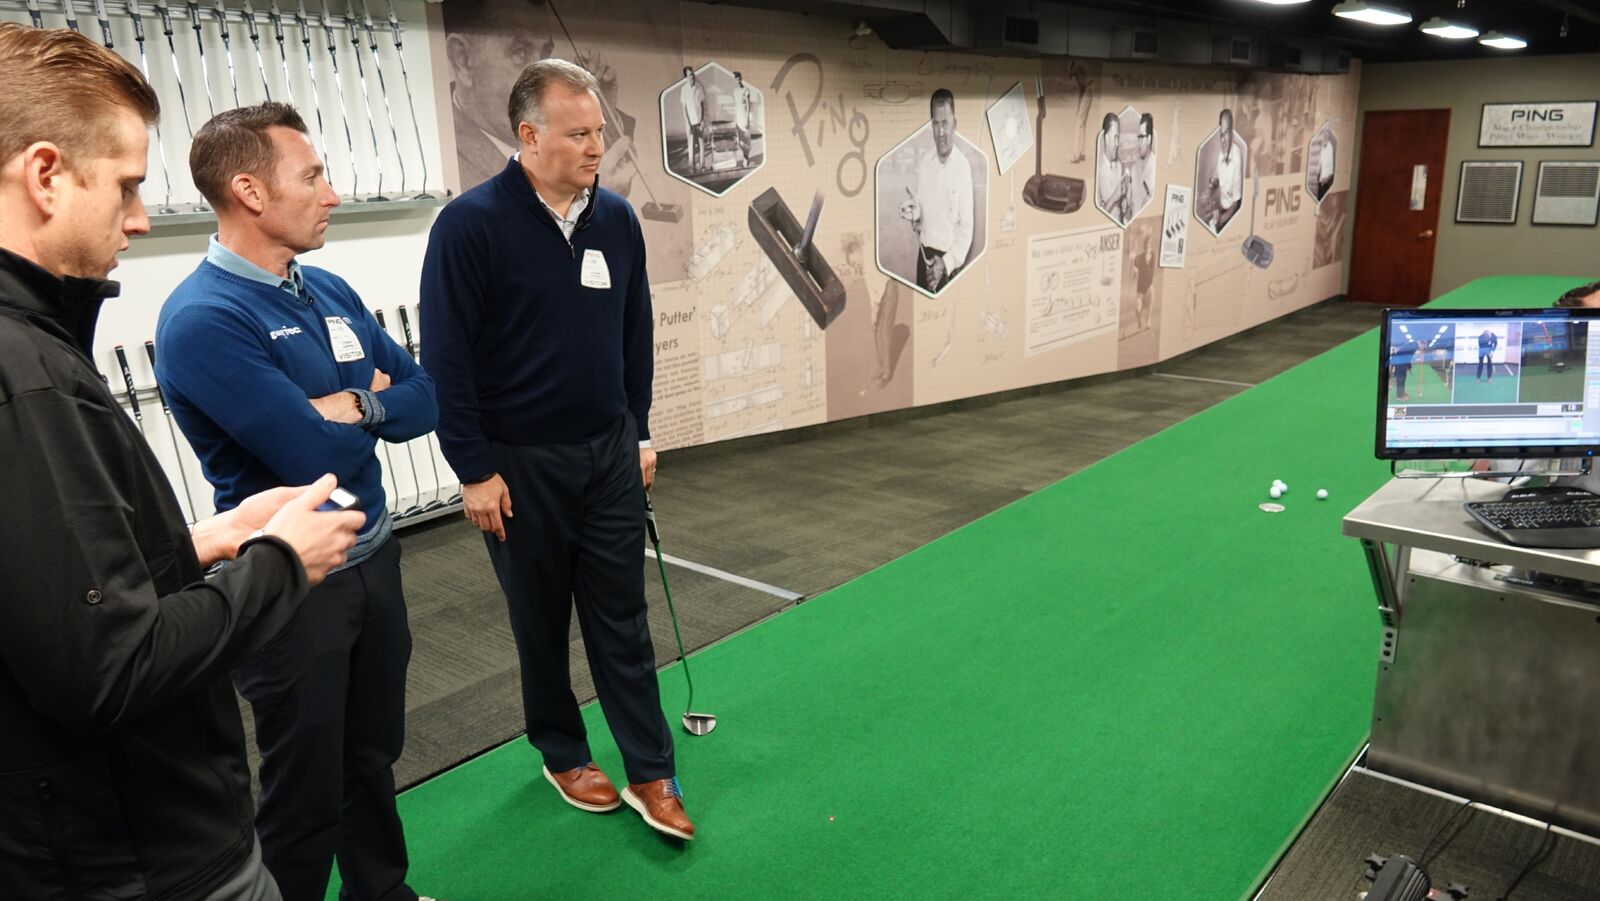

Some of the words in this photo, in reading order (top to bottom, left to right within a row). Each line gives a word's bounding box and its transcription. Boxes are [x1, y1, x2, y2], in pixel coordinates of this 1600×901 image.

[104, 27, 113, 44] PING
[1511, 109, 1564, 122] PING
[1264, 185, 1301, 217] PING
[1099, 233, 1121, 254] ANSER
[338, 350, 363, 360] VISITOR
